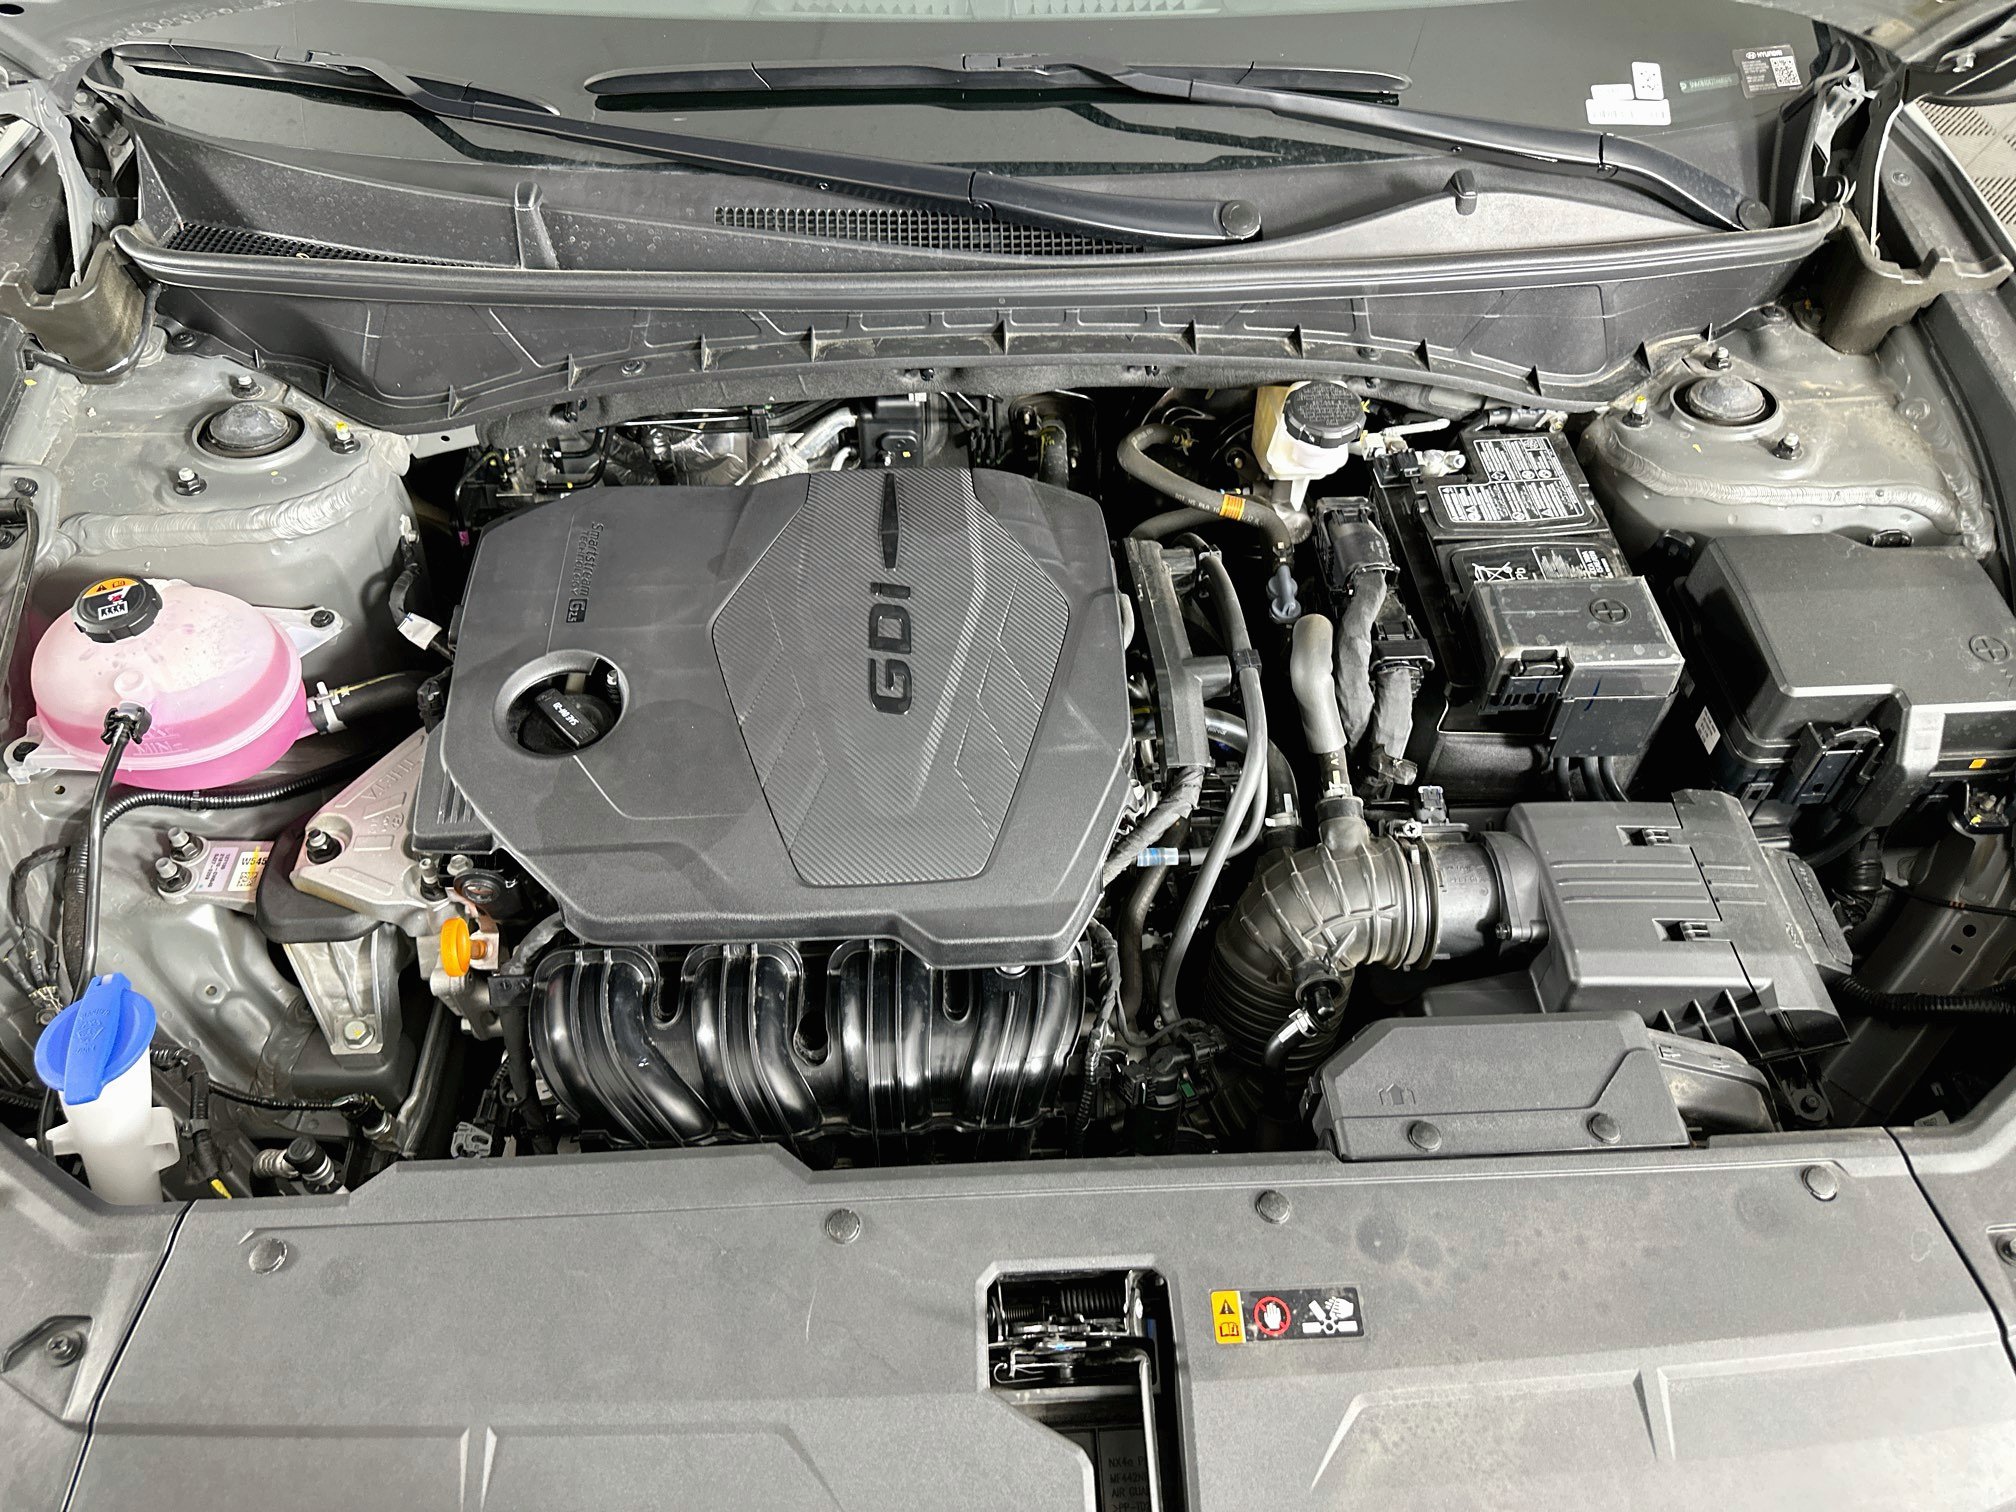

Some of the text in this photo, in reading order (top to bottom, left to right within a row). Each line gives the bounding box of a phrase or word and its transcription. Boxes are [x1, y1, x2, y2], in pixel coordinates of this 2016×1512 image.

[1757, 50, 1783, 58] HYUNDAI
[570, 530, 590, 597] TECHNOLOGY
[580, 521, 604, 597] Smartstream
[1515, 567, 1529, 580] Pb
[1112, 1487, 1126, 1499] AIR
